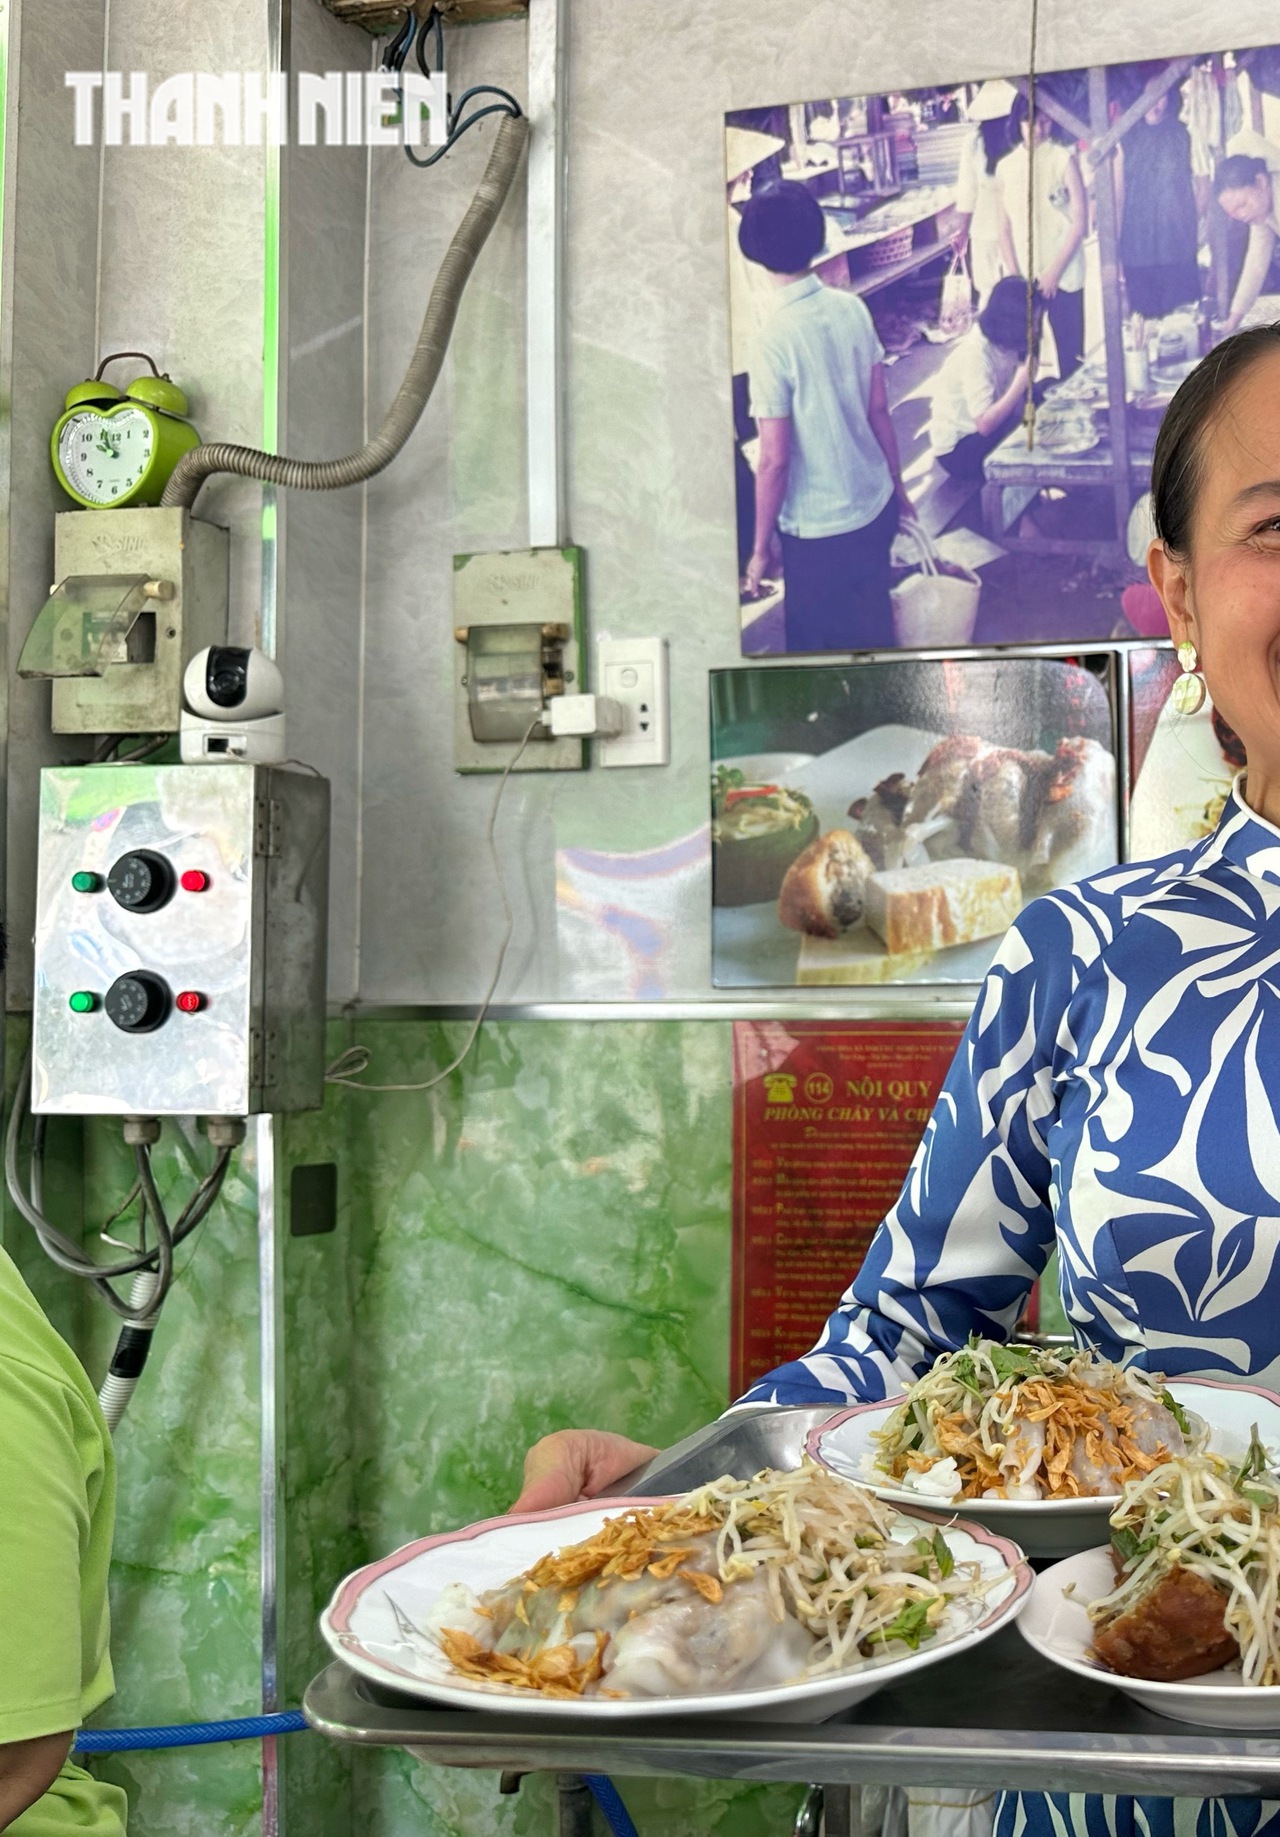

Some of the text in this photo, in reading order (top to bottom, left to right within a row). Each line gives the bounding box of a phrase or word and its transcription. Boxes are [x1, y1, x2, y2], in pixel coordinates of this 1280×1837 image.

[847, 1075, 882, 1100] NỘI
[889, 1080, 932, 1100] QUY
[763, 1104, 900, 1122] PHÒNG CHÁY VÀ
